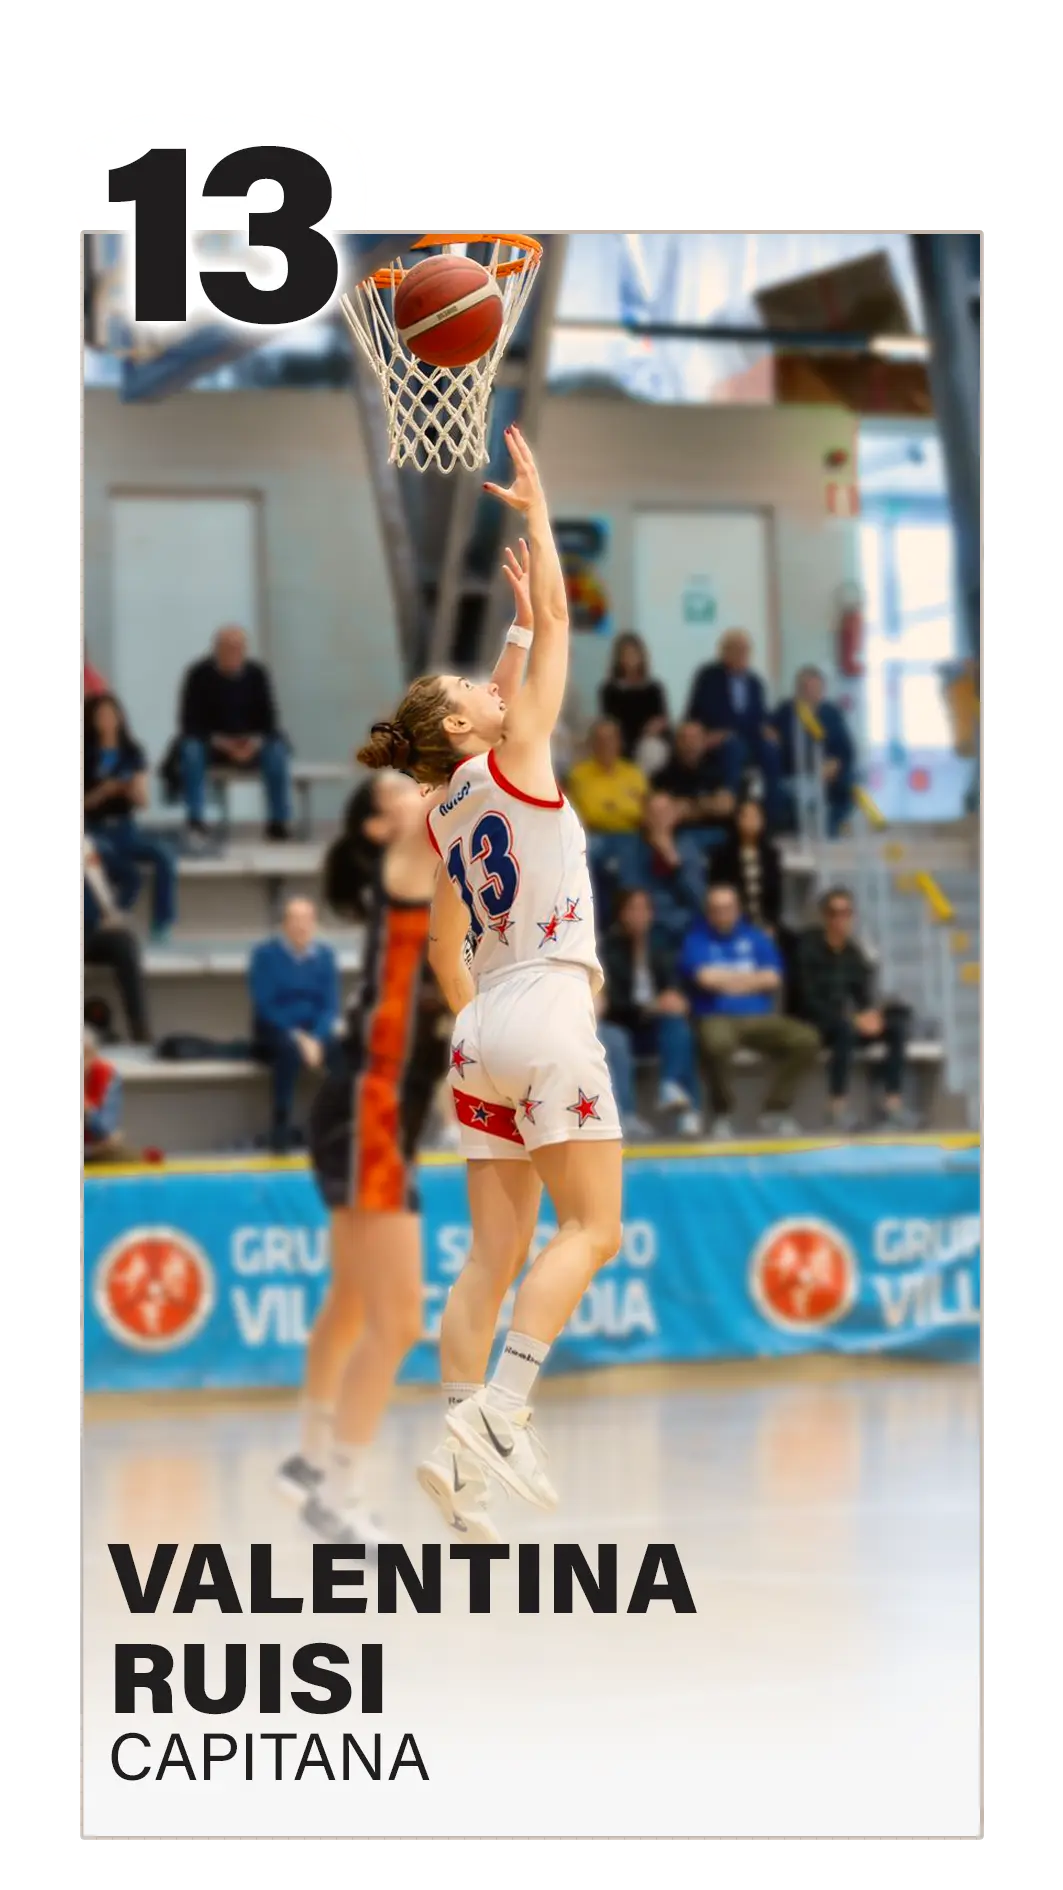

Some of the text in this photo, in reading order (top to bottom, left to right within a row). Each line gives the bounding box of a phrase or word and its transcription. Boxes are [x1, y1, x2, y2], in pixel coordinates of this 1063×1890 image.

[446, 810, 521, 942] 13
[231, 1225, 331, 1276] GRU
[230, 1285, 312, 1345] VIL
